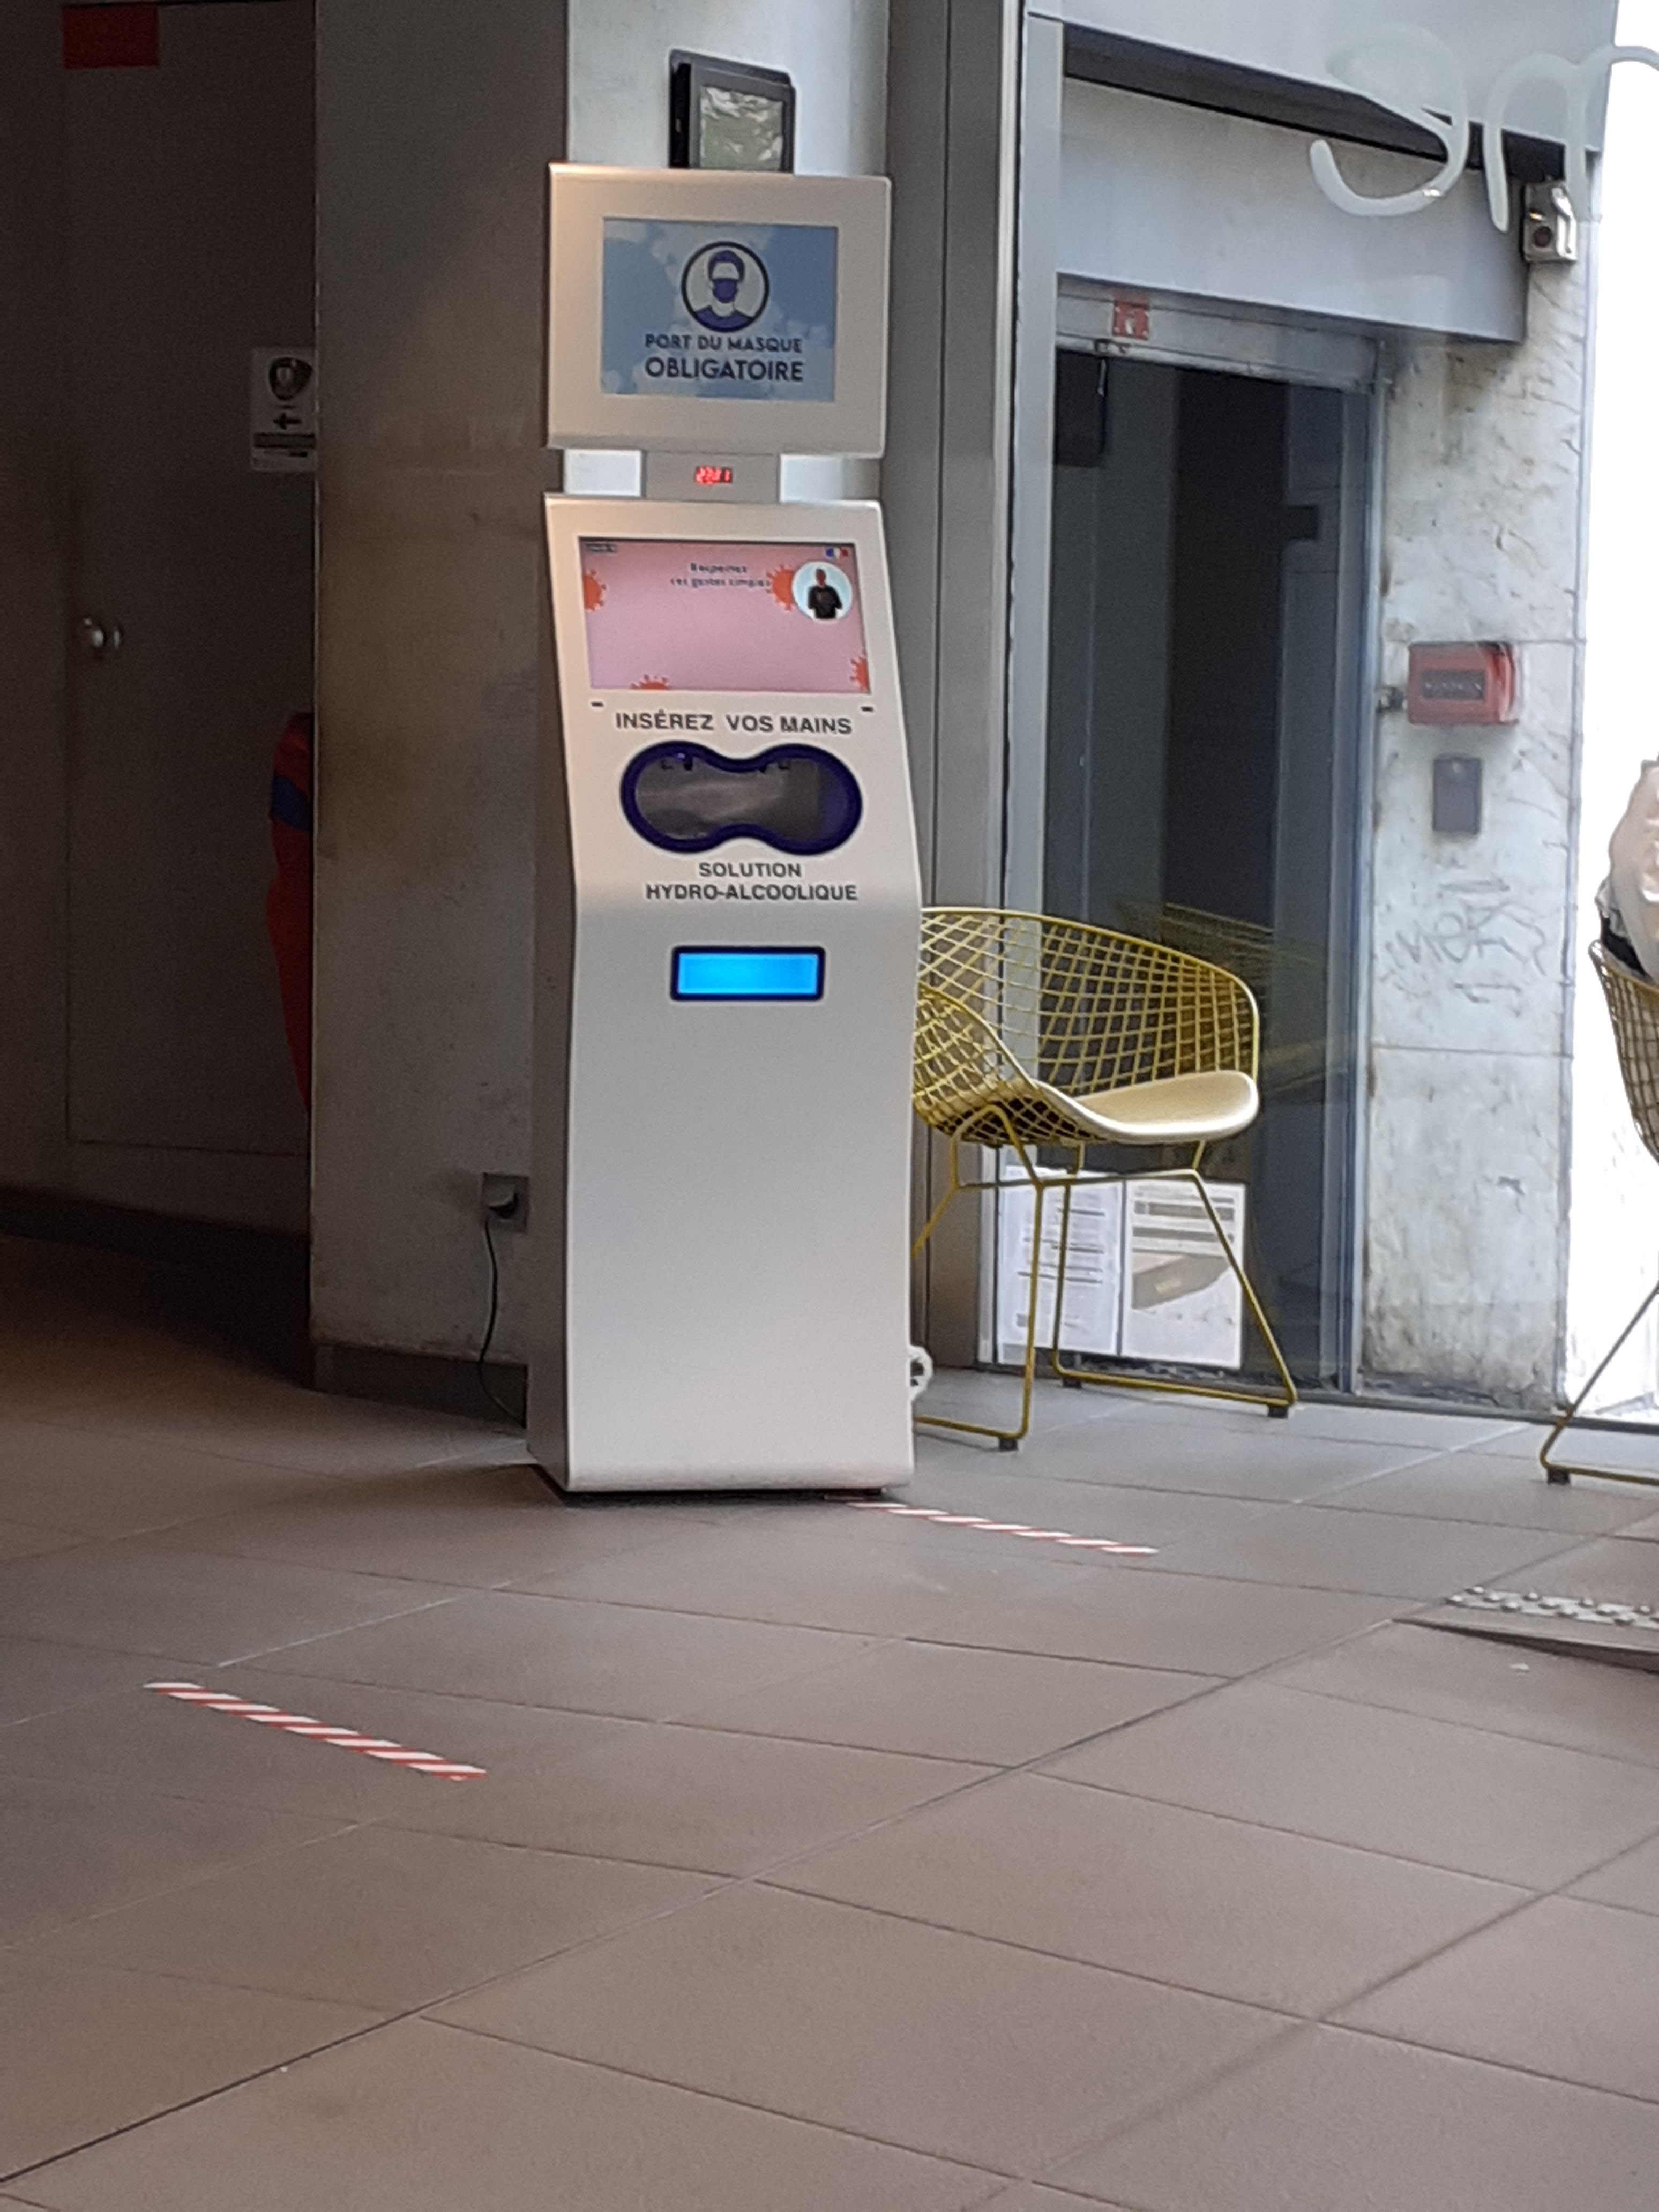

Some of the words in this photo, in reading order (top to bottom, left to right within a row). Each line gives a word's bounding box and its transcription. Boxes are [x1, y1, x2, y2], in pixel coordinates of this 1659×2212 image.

[645, 333, 690, 349] PORT
[698, 335, 722, 352] DU
[727, 336, 802, 353] MASQUE
[645, 356, 804, 382] OBLIGATOIRE
[616, 709, 714, 730] INSÉREZ
[726, 715, 773, 731] VOS
[780, 716, 853, 735] MAINS
[698, 862, 802, 878] SOLUTION
[645, 884, 858, 902] HYDRO-ALCOOLIQUE
